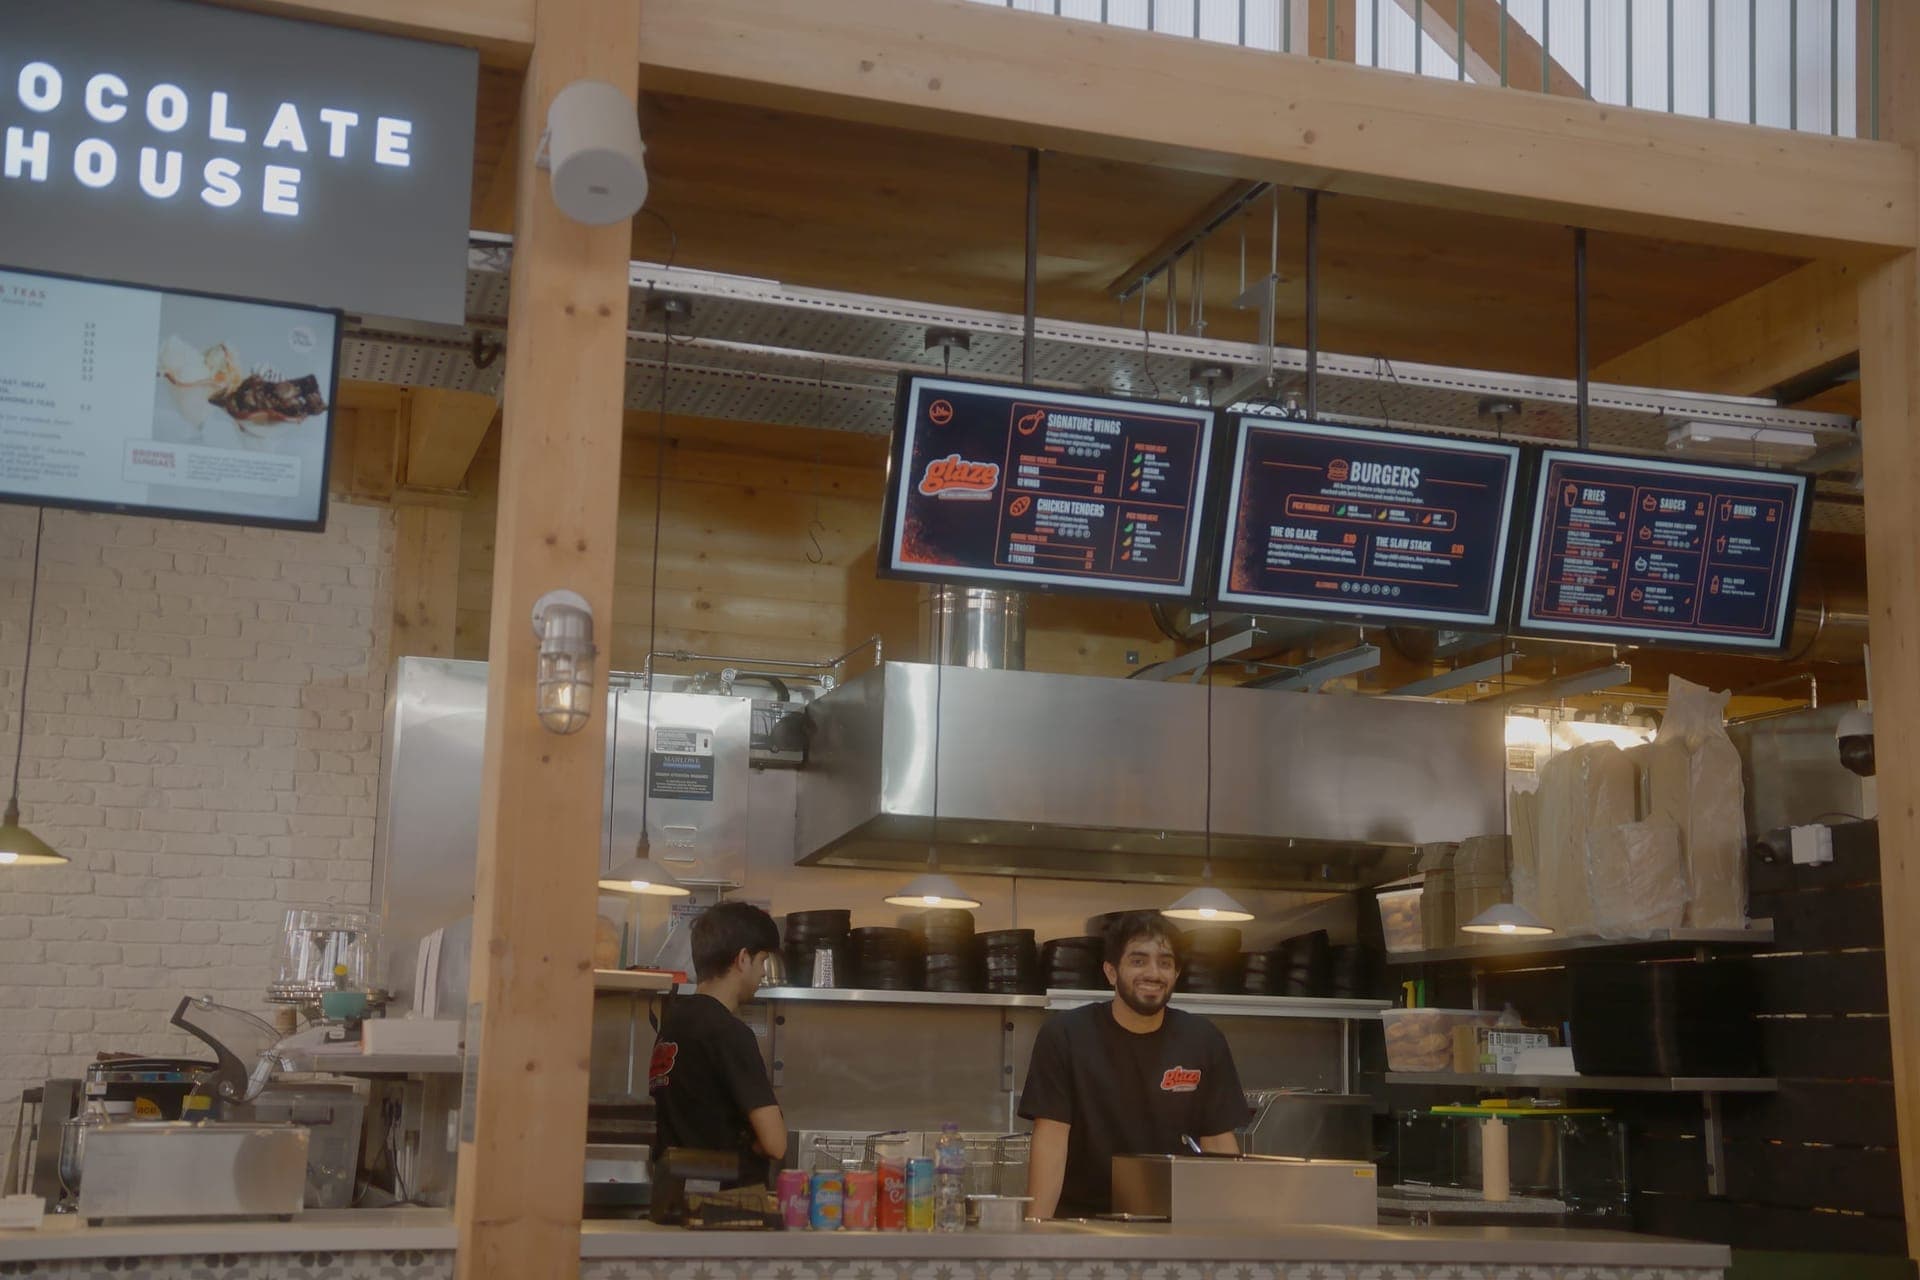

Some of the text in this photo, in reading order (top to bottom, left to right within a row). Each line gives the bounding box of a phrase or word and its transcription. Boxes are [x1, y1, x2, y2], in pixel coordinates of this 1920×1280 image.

[18, 61, 412, 167] OCOLATE
[4, 126, 302, 216] HOUSE
[1047, 413, 1121, 435] SIGNATURE WINGS
[919, 453, 999, 495] glaze
[1350, 461, 1420, 488] BURGERS
[1583, 488, 1606, 502] FRIES
[1660, 497, 1687, 511] SAUCES
[1037, 498, 1105, 517] CHICKEN TENDERS
[1733, 504, 1757, 517] DRINKS
[1270, 526, 1319, 540] THE OG GLAZE
[1376, 536, 1432, 552] THE SLAW STACK
